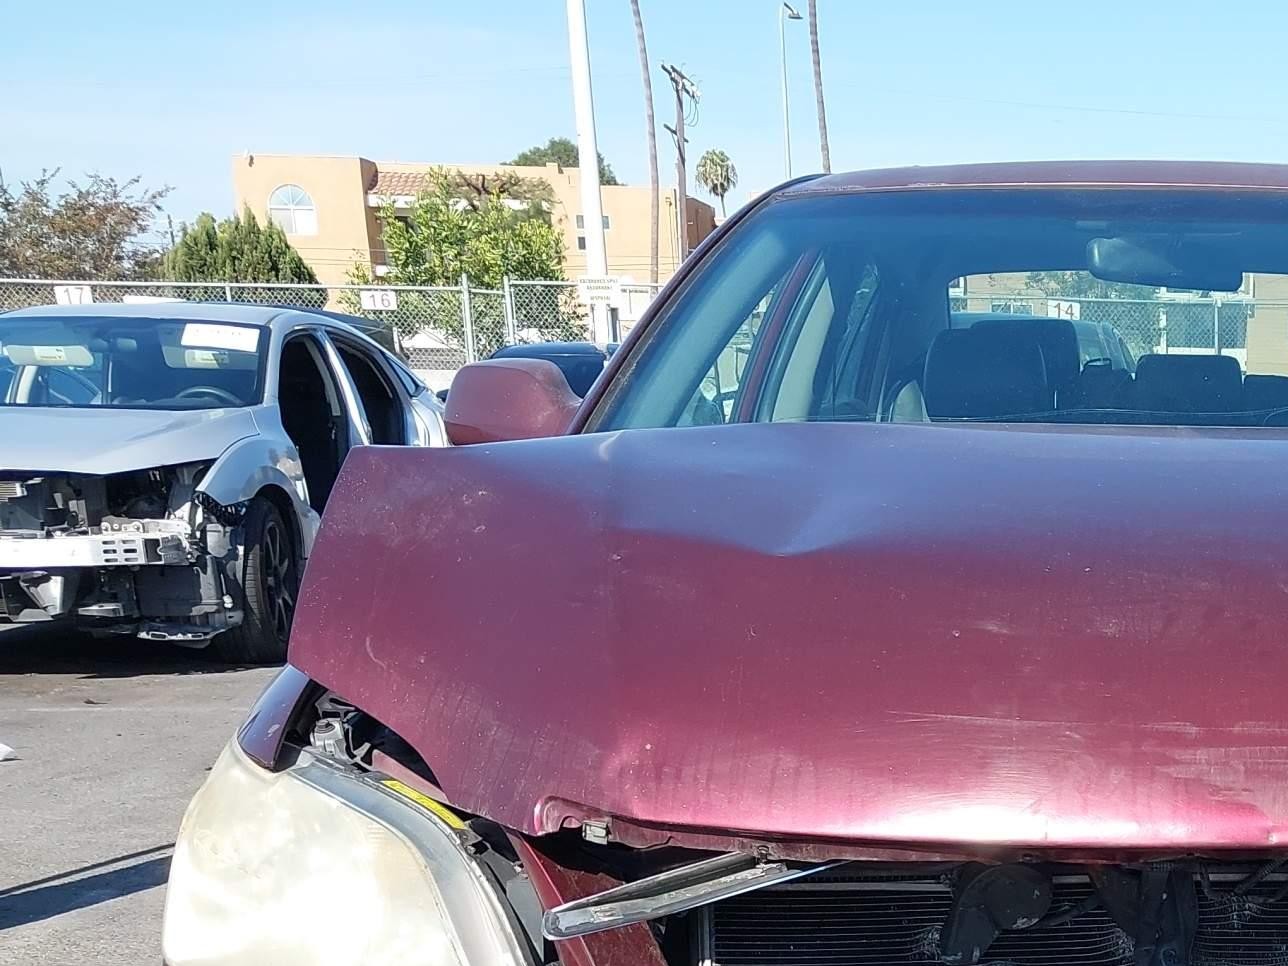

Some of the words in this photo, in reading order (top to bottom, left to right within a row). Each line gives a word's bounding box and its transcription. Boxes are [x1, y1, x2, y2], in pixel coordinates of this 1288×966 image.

[63, 286, 85, 304] 17
[369, 292, 391, 308] 16
[1053, 302, 1075, 320] 14
